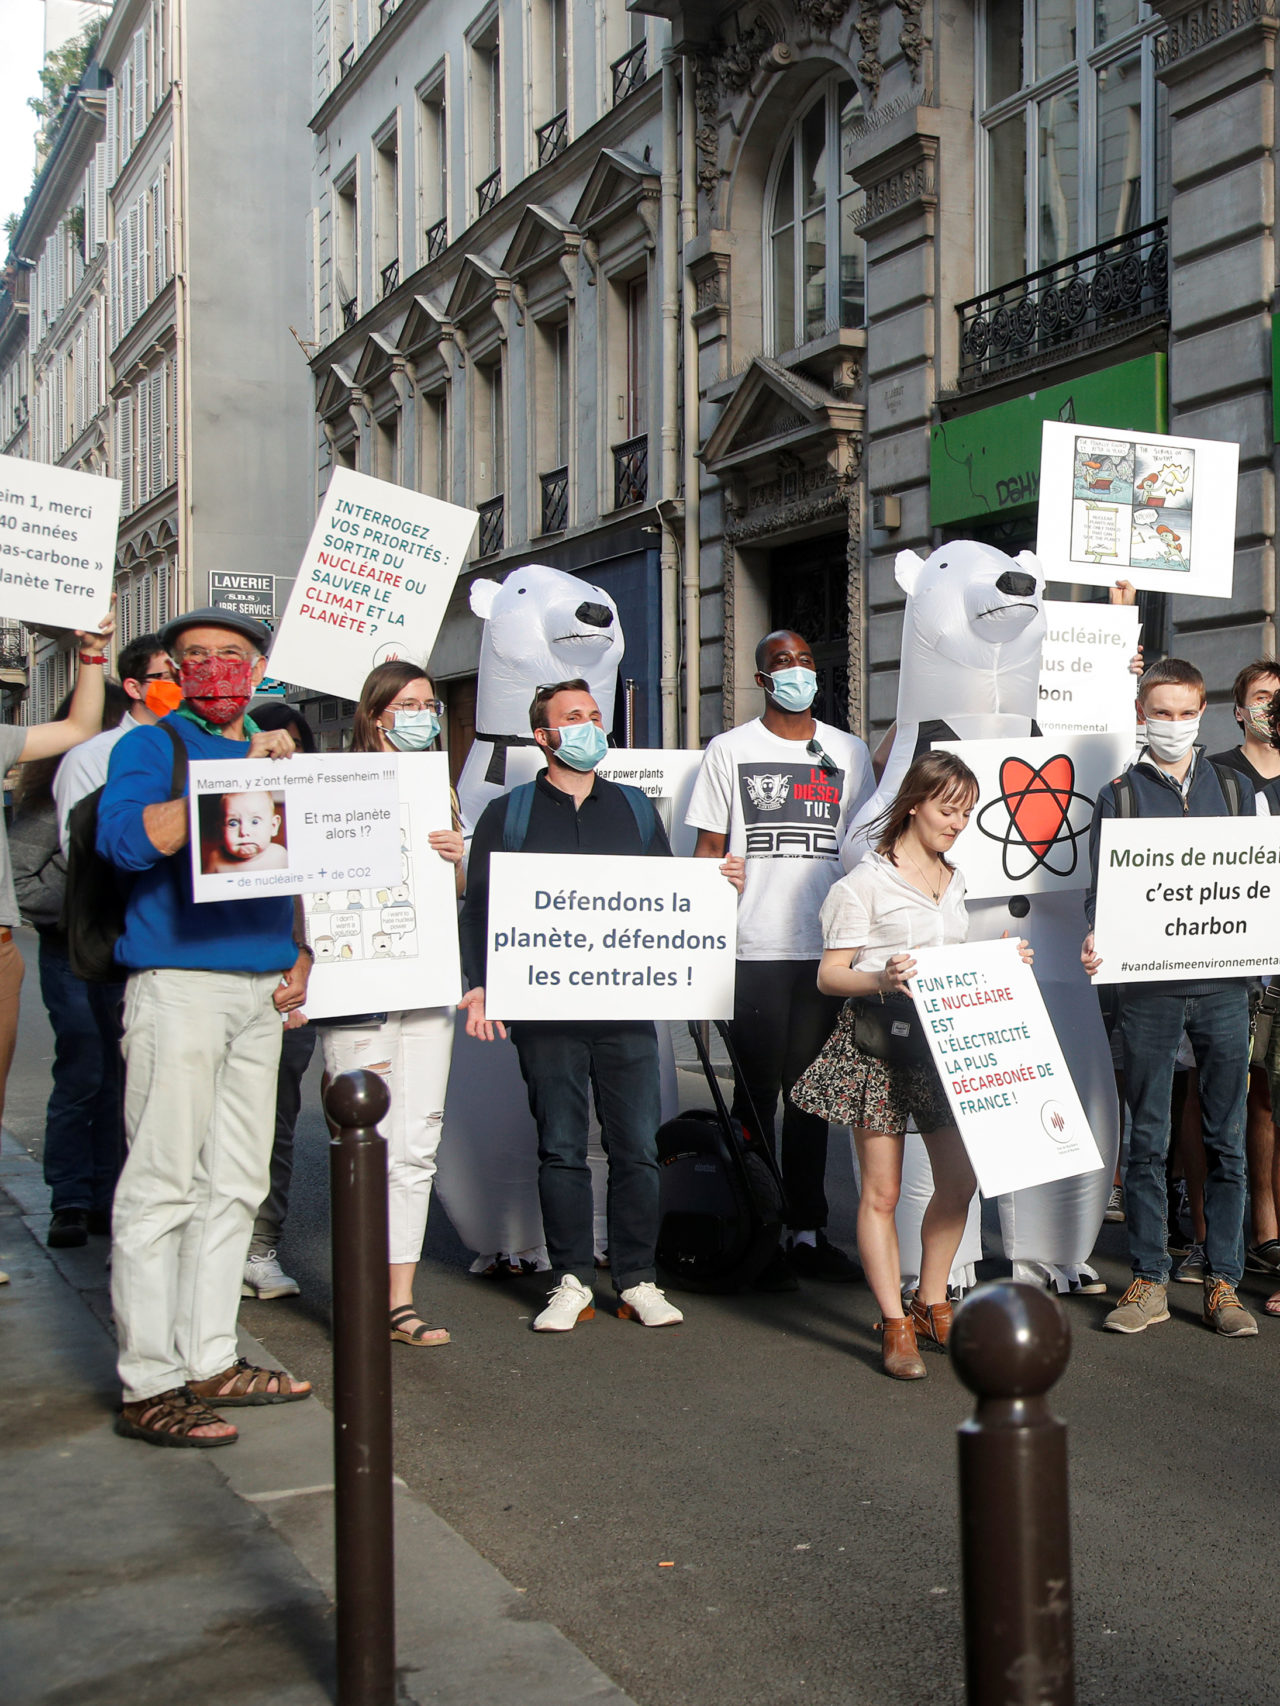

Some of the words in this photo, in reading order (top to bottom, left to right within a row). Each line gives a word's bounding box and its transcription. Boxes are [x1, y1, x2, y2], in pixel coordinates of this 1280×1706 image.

[31, 495, 43, 511] 1,
[49, 500, 92, 519] merci
[0, 515, 17, 530] 40
[22, 522, 78, 542] années
[335, 499, 430, 540] INTERROGEZ
[323, 534, 380, 562] SORTIR
[383, 553, 404, 569] DU
[331, 516, 361, 537] VOS
[363, 527, 443, 563] PRIORITÉS
[444, 556, 450, 566] :
[0, 542, 90, 569] as-carbone
[215, 575, 270, 590] LAVERIE
[318, 551, 403, 588] NUCLÉAIRE
[405, 579, 426, 595] OU
[54, 579, 95, 598] Terre
[311, 569, 371, 597] SAUVER
[374, 588, 392, 604] LE
[240, 603, 272, 615] SERVICE
[306, 587, 365, 613] CLIMAT
[366, 605, 386, 620] ET
[388, 611, 405, 627] LA
[299, 603, 366, 634] PLANÈTE
[370, 624, 378, 636] ?
[1071, 657, 1093, 673] de
[197, 779, 242, 791] Maman,
[245, 779, 252, 789] y
[255, 776, 281, 787] z'ont
[283, 774, 314, 786] fermé
[317, 771, 380, 784] Fessenheim
[383, 770, 396, 781] !!!!
[613, 770, 638, 780] power
[640, 768, 664, 780] plants
[810, 768, 829, 784] LE
[793, 784, 840, 804] DIESEL
[304, 812, 319, 824] Et
[322, 812, 342, 824] ma
[345, 809, 391, 825] planète
[804, 801, 831, 818] TUE
[325, 827, 357, 840] alors
[361, 825, 372, 838] !?
[1110, 848, 1174, 867] Moins
[1181, 847, 1206, 866] de
[237, 876, 252, 887] de
[255, 873, 304, 886] nucléaire
[318, 868, 328, 878] +
[331, 870, 345, 880] de
[347, 867, 371, 879] CO2
[535, 890, 664, 912] Défendons
[672, 892, 691, 913] la
[1200, 882, 1241, 905] plus
[1247, 880, 1271, 899] de
[1165, 916, 1247, 936] charbon
[494, 927, 595, 952] planète,
[602, 928, 727, 950] défendons
[528, 965, 561, 986] les
[568, 966, 678, 987] centrales
[687, 966, 693, 986] !
[917, 977, 945, 993] FUN
[946, 971, 978, 990] FACT
[982, 974, 987, 984] :
[924, 999, 941, 1014] LE
[941, 987, 1014, 1011] NUCLÉAIRE
[931, 1017, 955, 1034] EST
[945, 1060, 963, 1075] LA
[964, 1053, 998, 1071] PLUS
[952, 1064, 1036, 1095] DÉCARBONÉE
[1036, 1062, 1054, 1079] DE
[960, 1093, 1011, 1116] FRANCE
[1012, 1092, 1018, 1104] !
